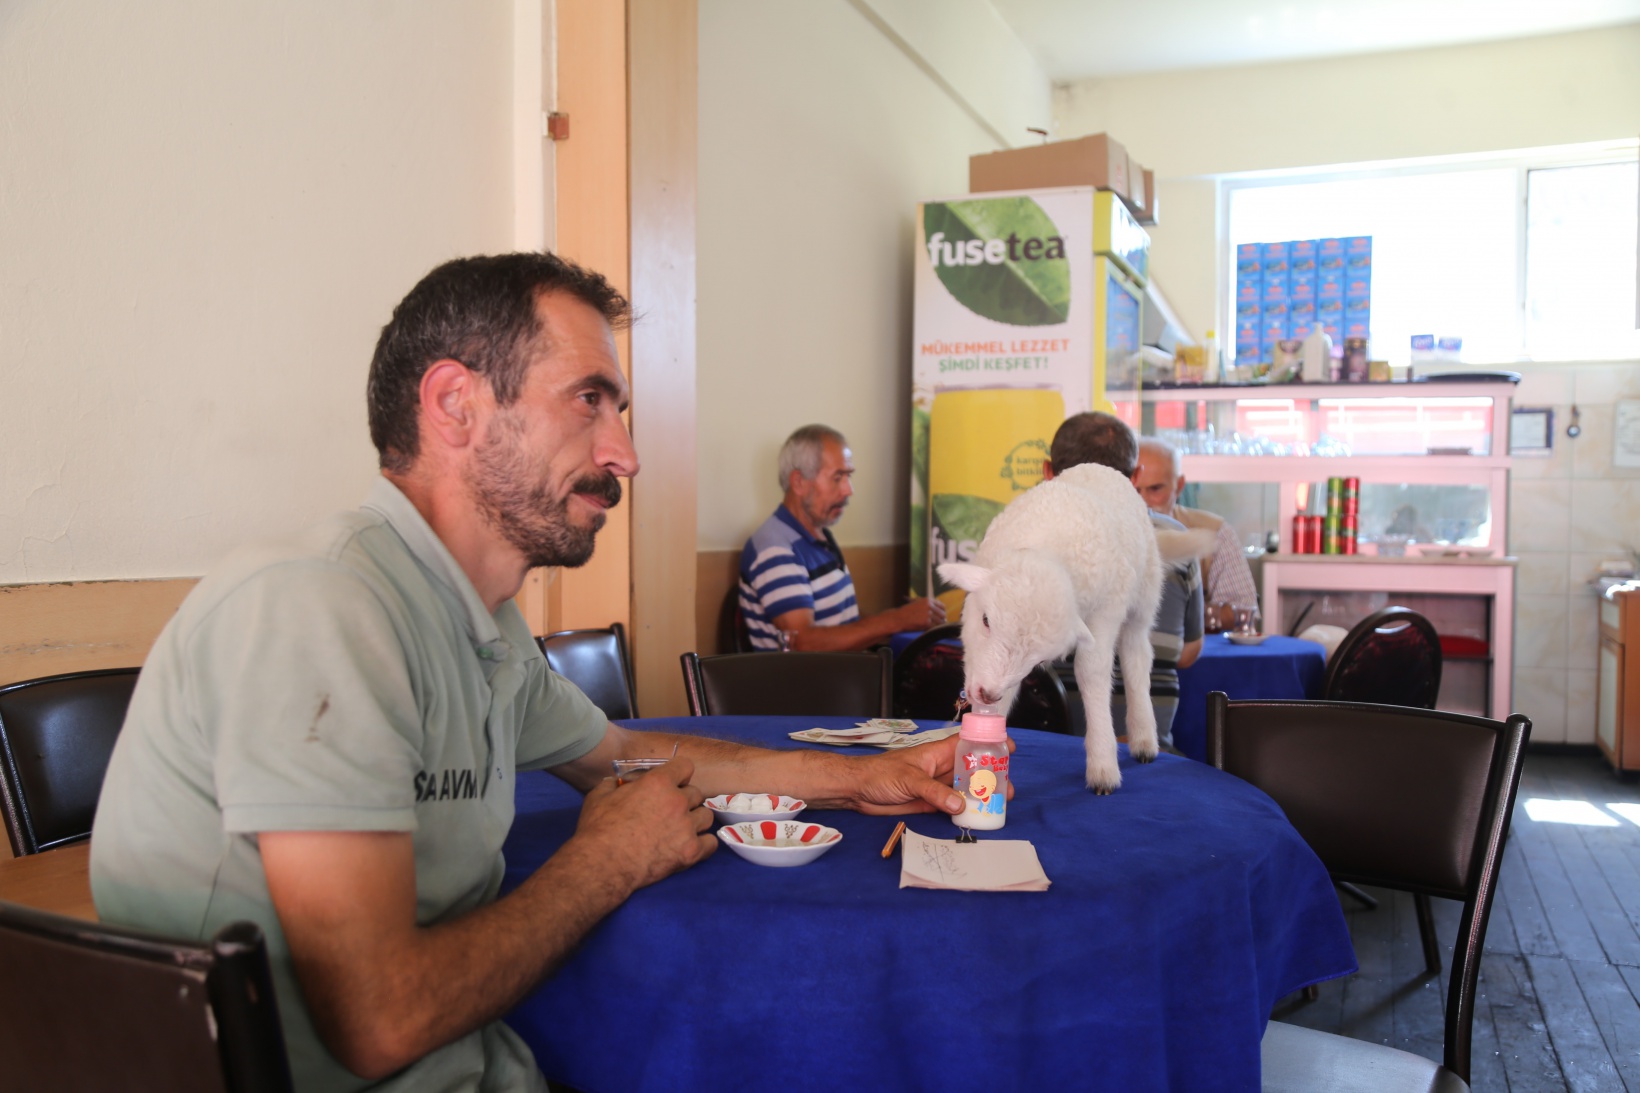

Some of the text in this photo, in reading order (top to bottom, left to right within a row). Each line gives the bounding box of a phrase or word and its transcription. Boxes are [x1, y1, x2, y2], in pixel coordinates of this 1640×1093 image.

[928, 231, 1066, 267] fusetea
[921, 339, 1069, 355] MÜKEMMEL LEZZET
[939, 356, 1048, 373] ŞİMDİ KEŞFET!
[931, 526, 979, 565] fus
[980, 754, 1008, 767] Star
